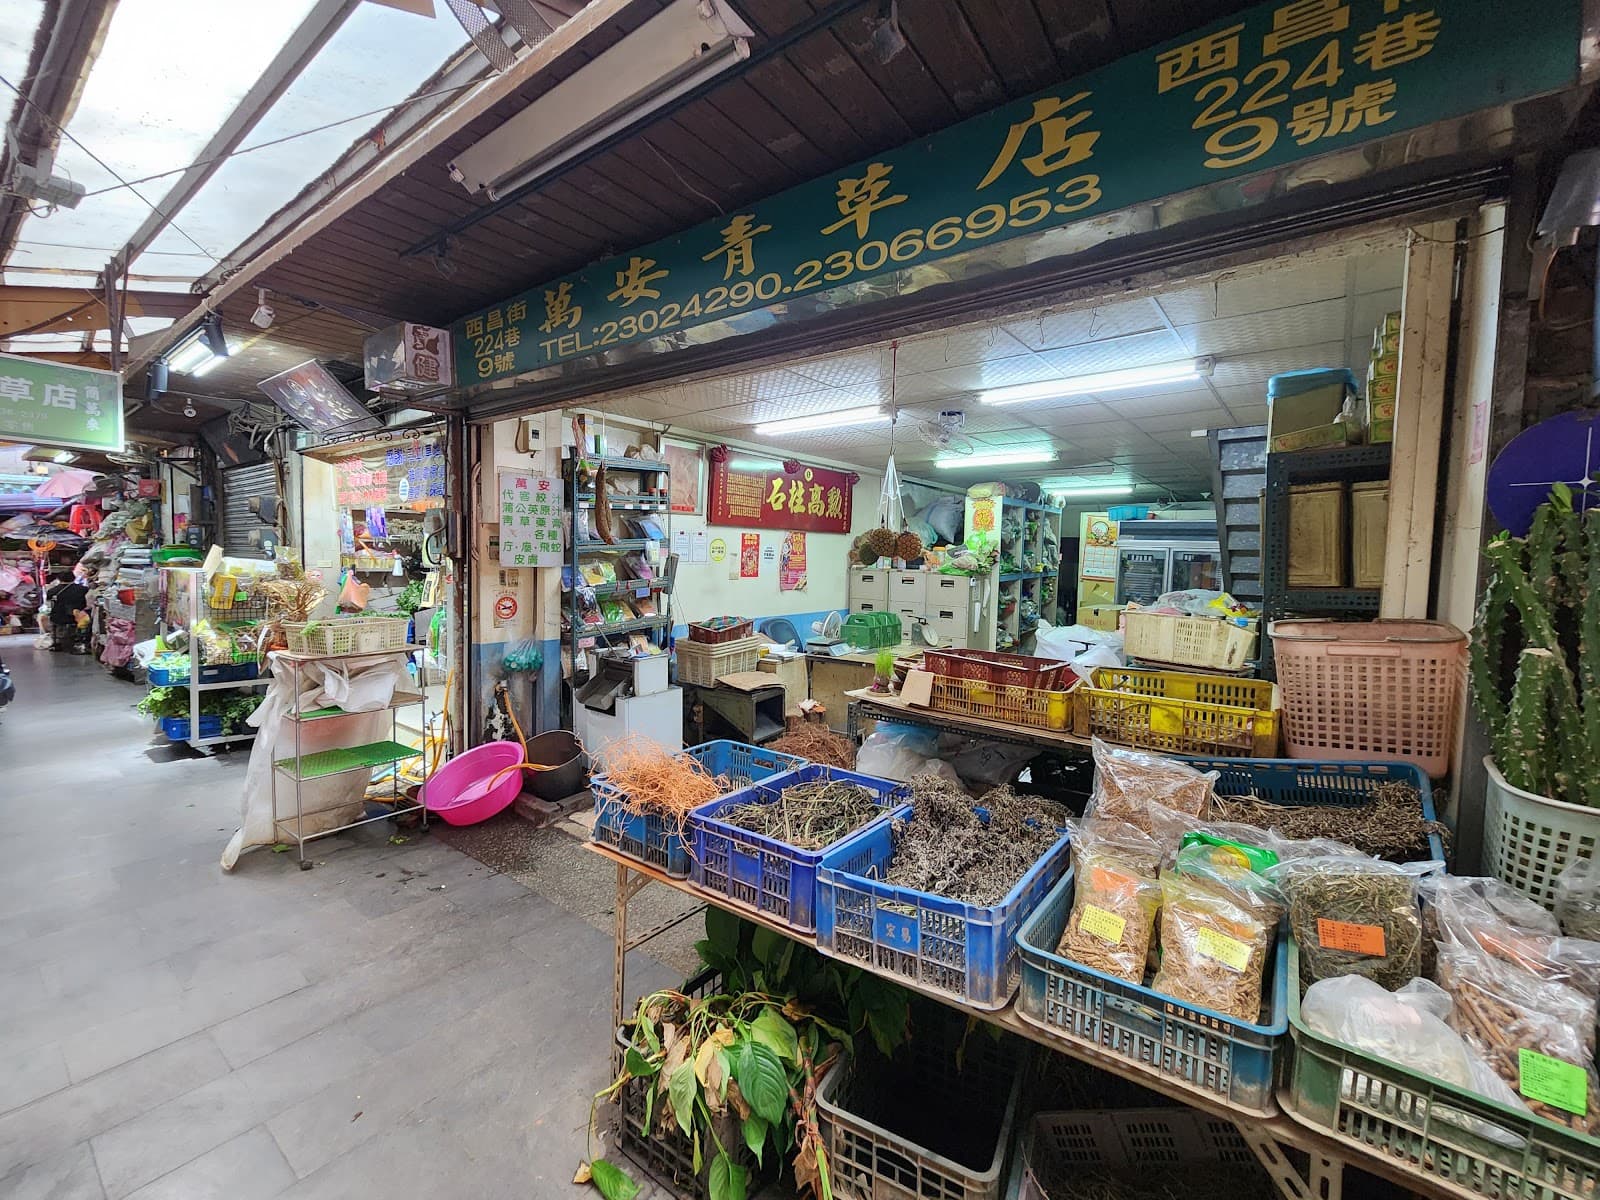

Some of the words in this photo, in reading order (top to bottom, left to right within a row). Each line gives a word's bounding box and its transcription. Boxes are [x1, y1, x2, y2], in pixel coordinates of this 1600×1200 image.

[1156, 0, 1412, 94] 西昌
[1192, 10, 1442, 129] 224巷
[1203, 78, 1397, 168] 9號
[538, 91, 1101, 334] 萬安青草店
[465, 300, 527, 339] 西昌街
[475, 327, 520, 358] 224巷
[478, 352, 515, 378] 9號
[515, 478, 550, 491] 萬安
[534, 529, 558, 540] 各種
[514, 554, 538, 565] 皮膚
